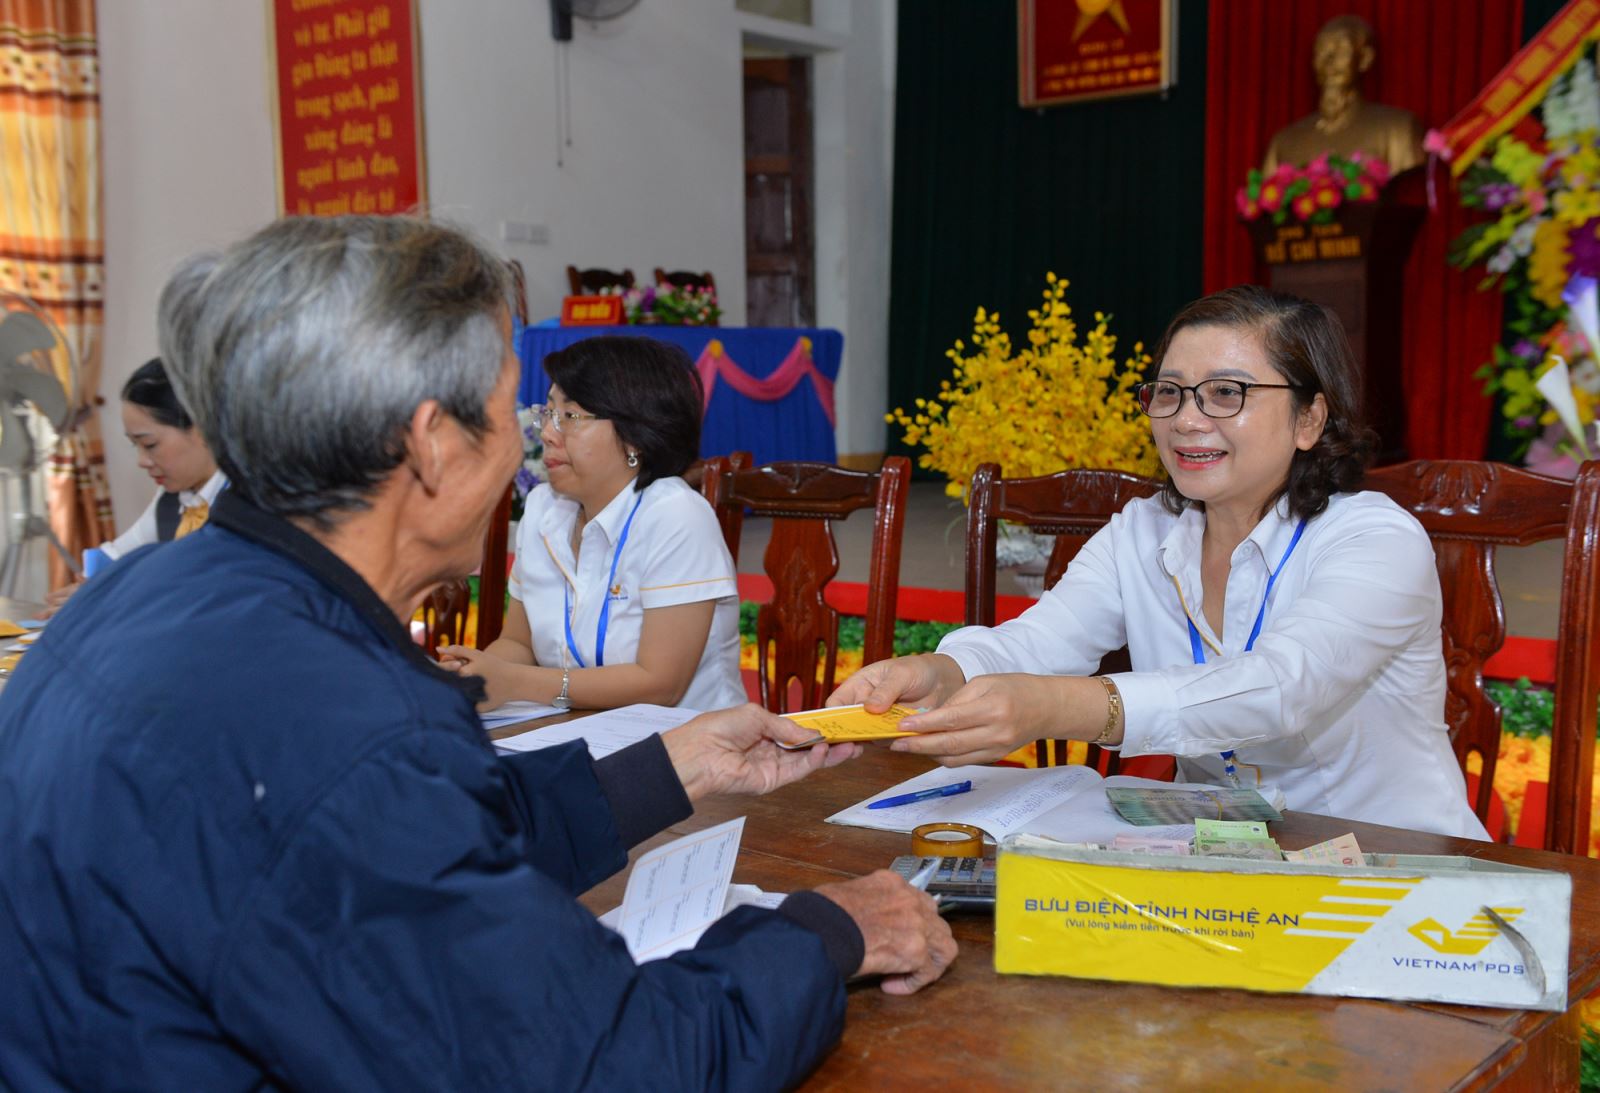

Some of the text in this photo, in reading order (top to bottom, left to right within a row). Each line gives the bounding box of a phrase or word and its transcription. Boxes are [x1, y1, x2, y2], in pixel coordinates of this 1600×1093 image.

[295, 96, 331, 119] trong
[1024, 898, 1299, 927] BƯU ĐIỆN TỈNH NGHỆ AN
[1065, 918, 1085, 929] (Vui
[1088, 919, 1110, 931] lòng
[1194, 925, 1210, 935] khi
[1232, 927, 1255, 939] bàn)
[1393, 957, 1525, 975] VIETNAM POS
